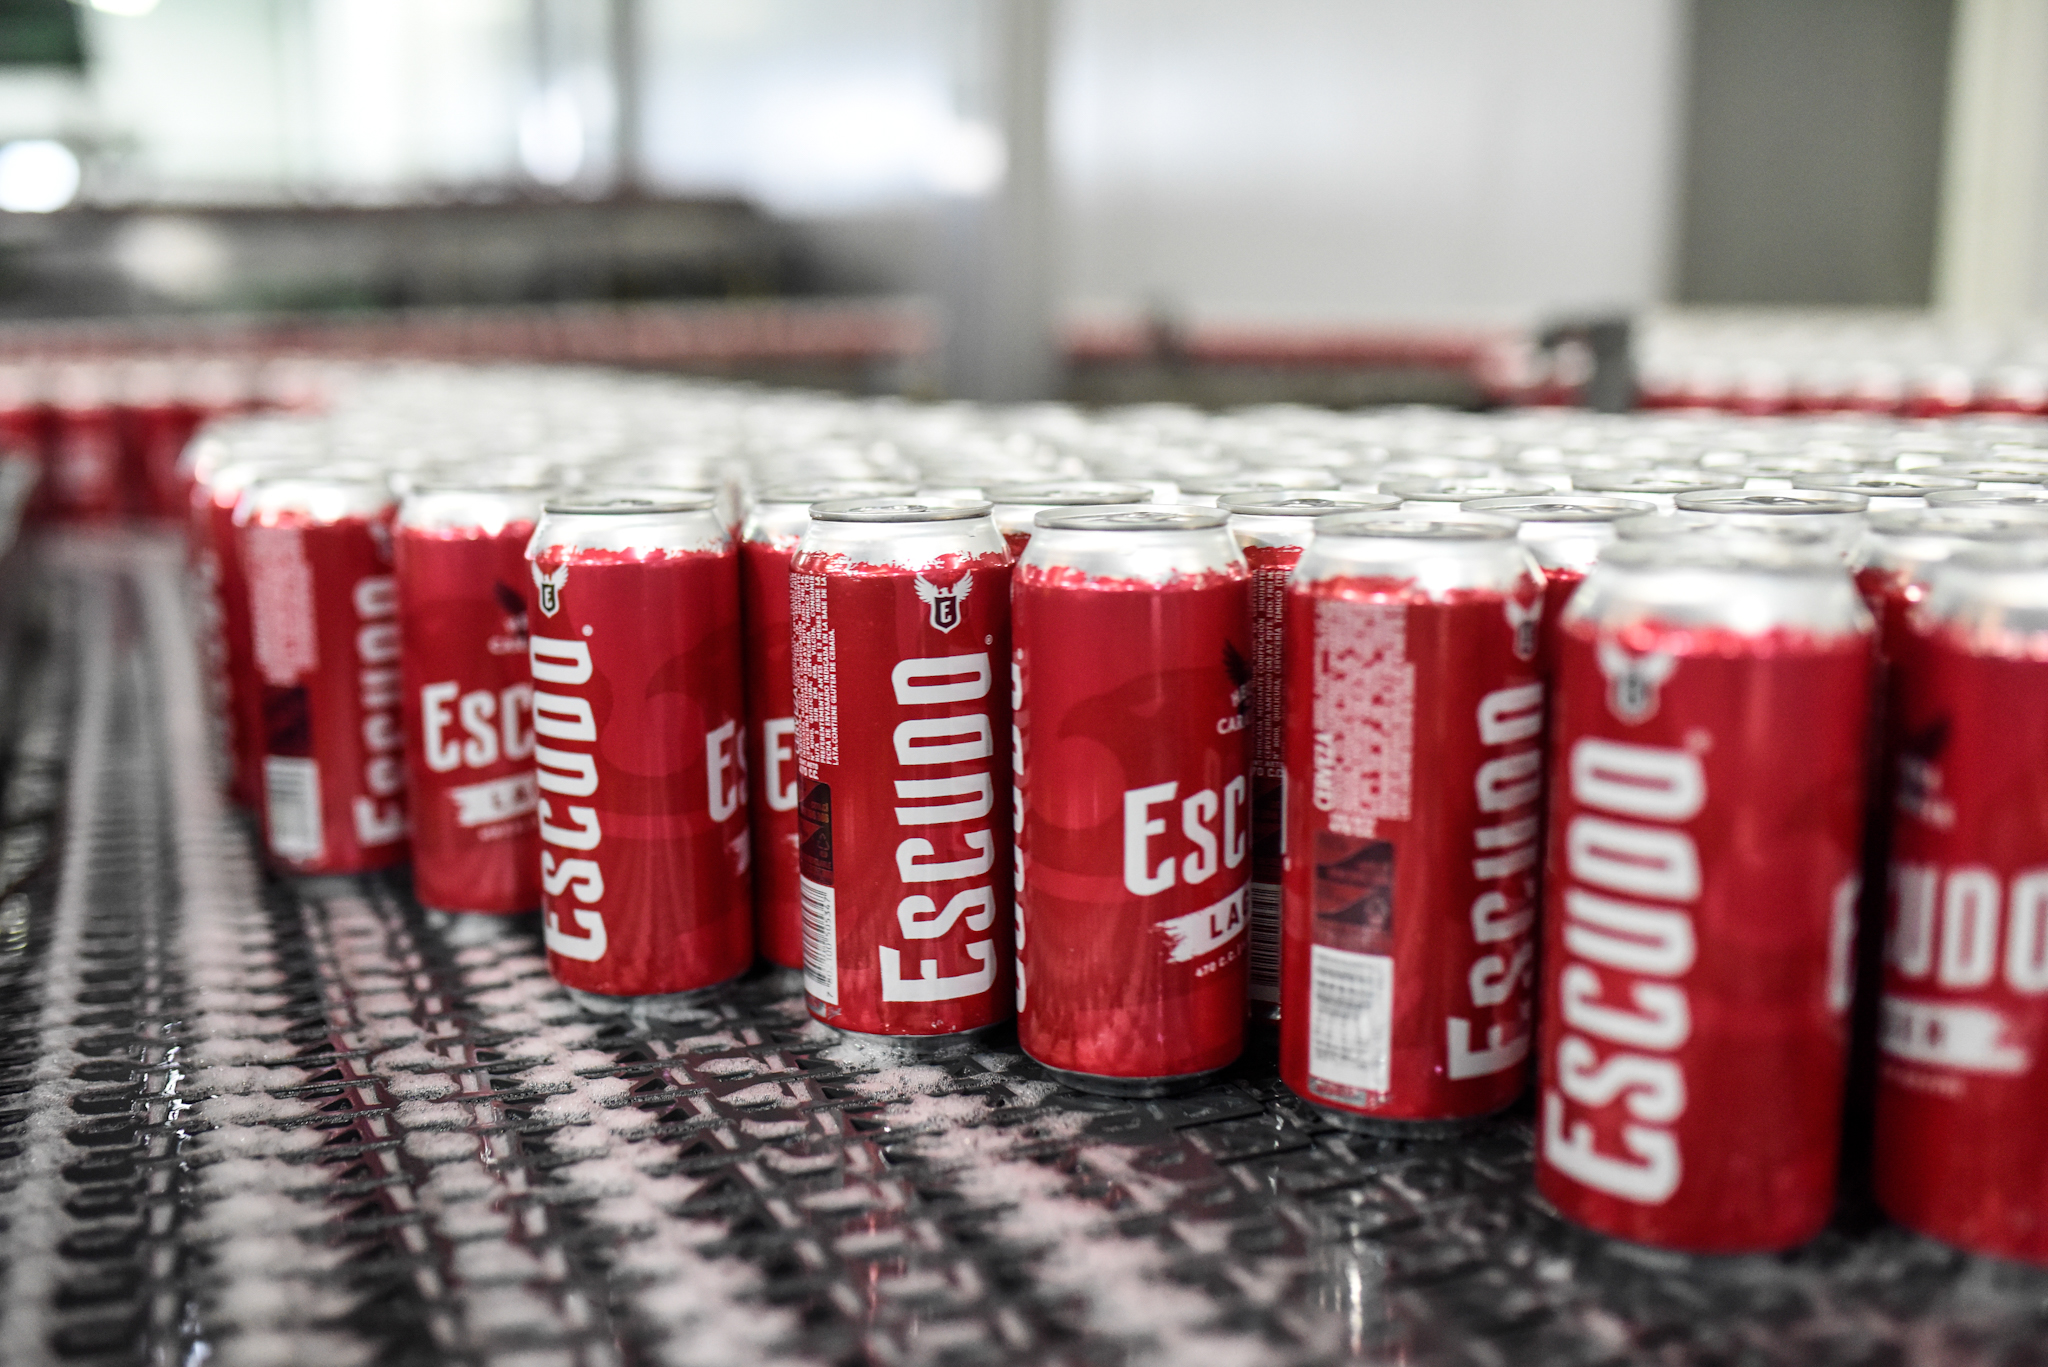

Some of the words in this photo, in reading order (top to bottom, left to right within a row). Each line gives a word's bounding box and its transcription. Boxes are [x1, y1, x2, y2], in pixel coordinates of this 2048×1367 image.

[815, 576, 821, 586] LA
[821, 577, 827, 586] LA
[821, 589, 827, 598] DE
[940, 600, 952, 623] E
[822, 622, 828, 631] LA
[822, 633, 828, 644] EN
[828, 628, 836, 661] CEBADA.
[817, 652, 822, 662] DE
[829, 662, 836, 672] DE
[818, 692, 826, 764] PREFERENTEMENTE
[825, 728, 831, 738] DE
[530, 634, 607, 963] ESCUDO
[878, 652, 997, 1002] ESCUDO
[1124, 775, 1246, 896] ESC
[1544, 735, 1707, 1205] ESCUDO
